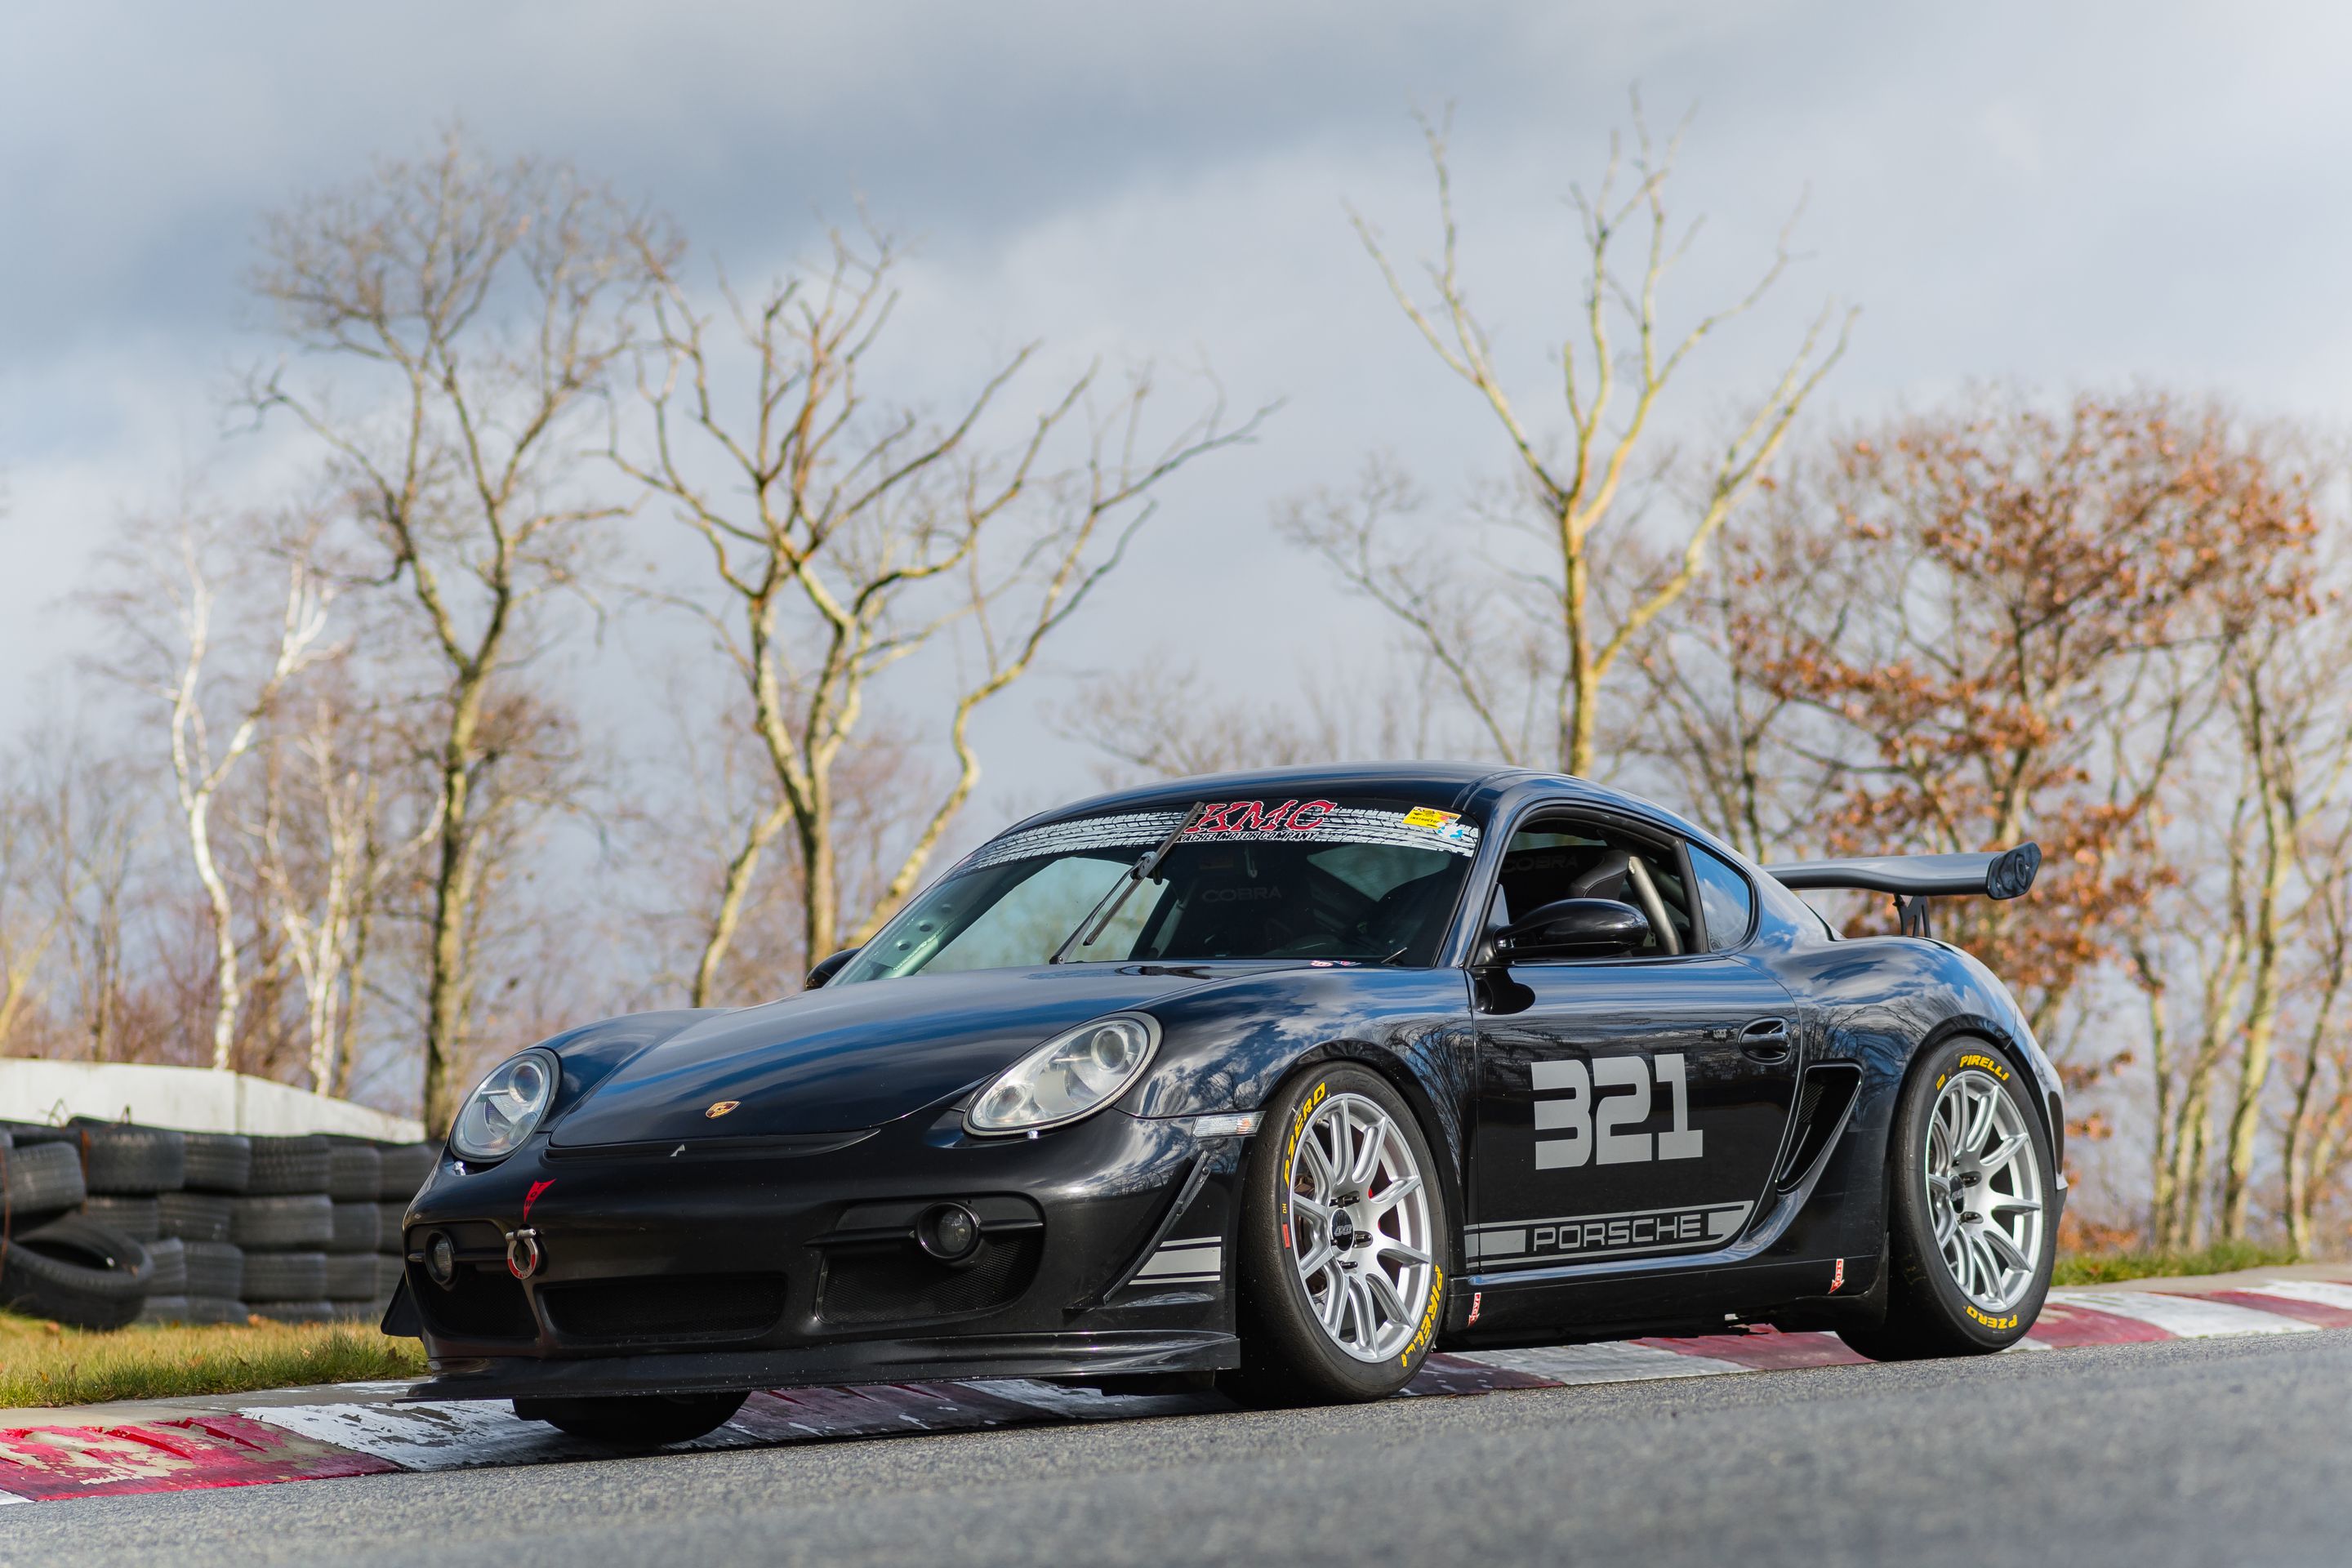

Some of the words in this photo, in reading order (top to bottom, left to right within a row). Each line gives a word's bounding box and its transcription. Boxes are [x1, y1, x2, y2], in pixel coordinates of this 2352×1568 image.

[1183, 800, 1337, 834] KMC
[1217, 831, 1260, 841] MOTOR
[1258, 831, 1316, 841] COMPANY
[1202, 886, 1282, 902] COBRA
[1959, 1054, 2010, 1080] PIRELLI
[1530, 1054, 1704, 1170] 321
[525, 1183, 545, 1206] TOW
[1534, 1214, 1702, 1251] PORSCHE
